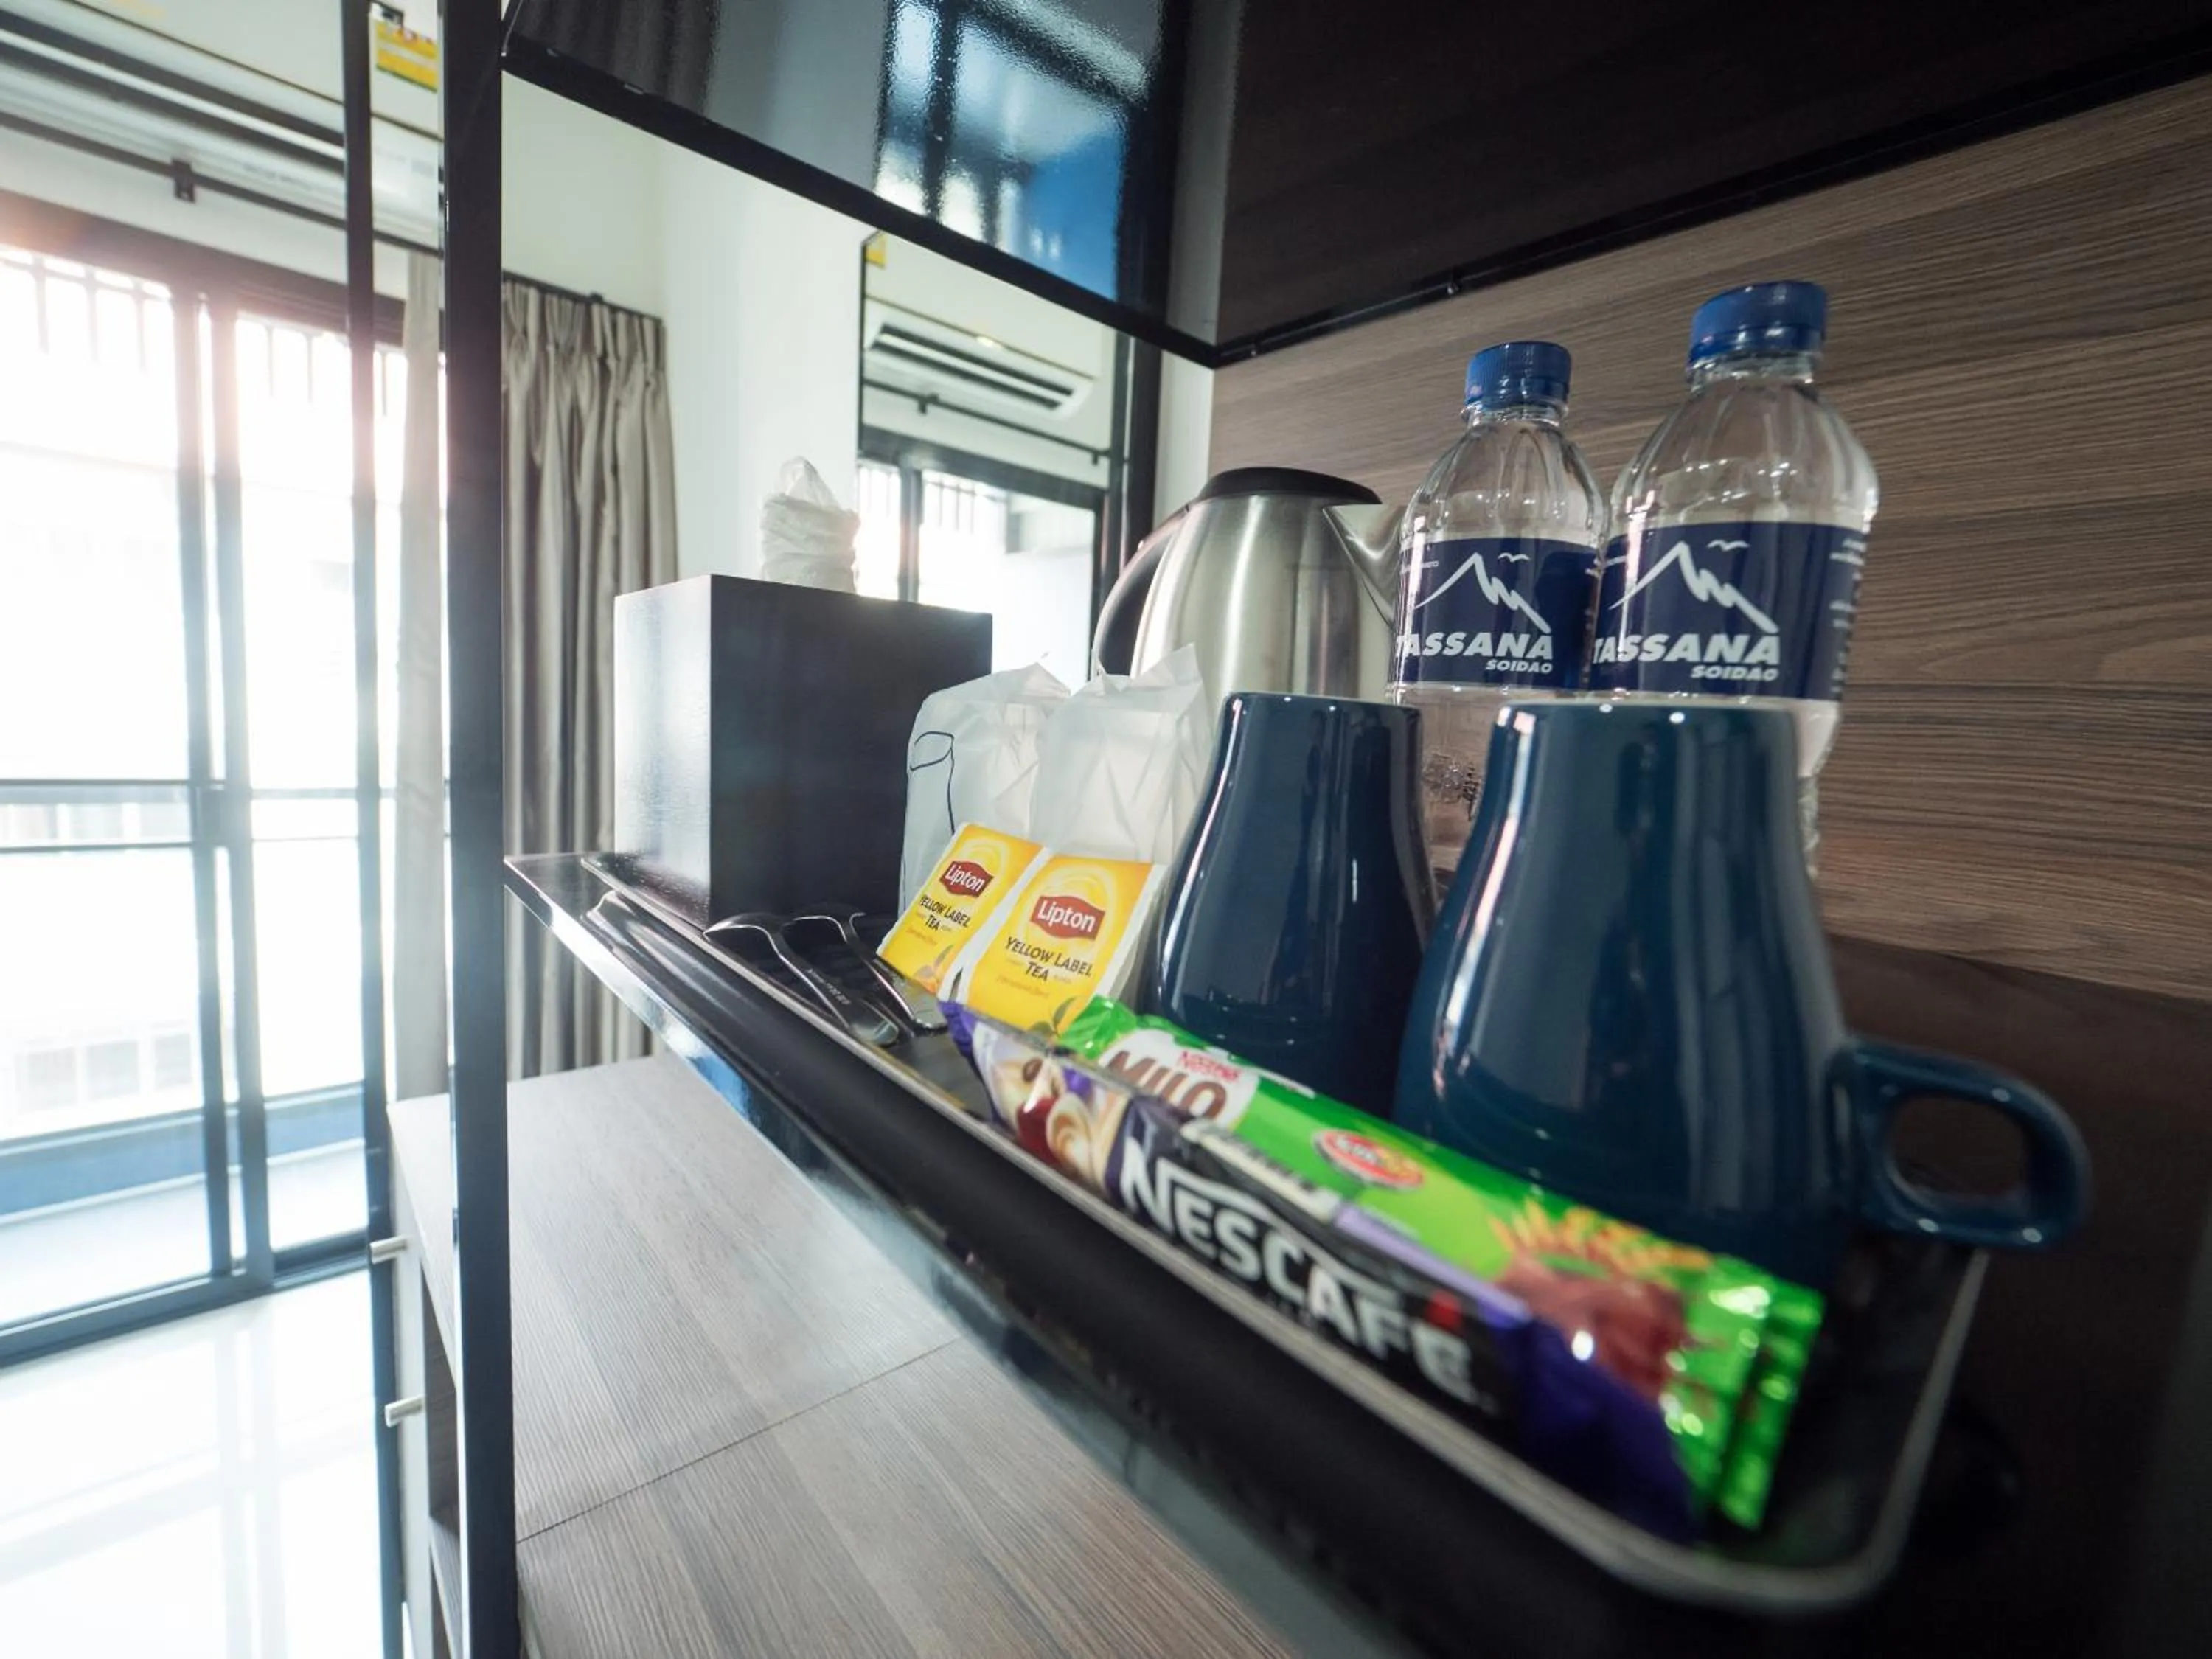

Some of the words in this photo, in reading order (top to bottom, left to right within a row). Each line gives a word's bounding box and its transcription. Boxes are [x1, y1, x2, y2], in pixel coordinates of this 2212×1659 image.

[1486, 658, 1553, 674] SOIDAO
[1691, 665, 1779, 681] SOIDAO
[945, 863, 985, 892] Lipton
[925, 914, 941, 931] TEA
[944, 905, 971, 928] LABEL
[1037, 900, 1096, 933] Lipton
[1005, 936, 1054, 962] YELLOW
[1054, 953, 1094, 977] LABEL
[1026, 961, 1050, 982] TEA
